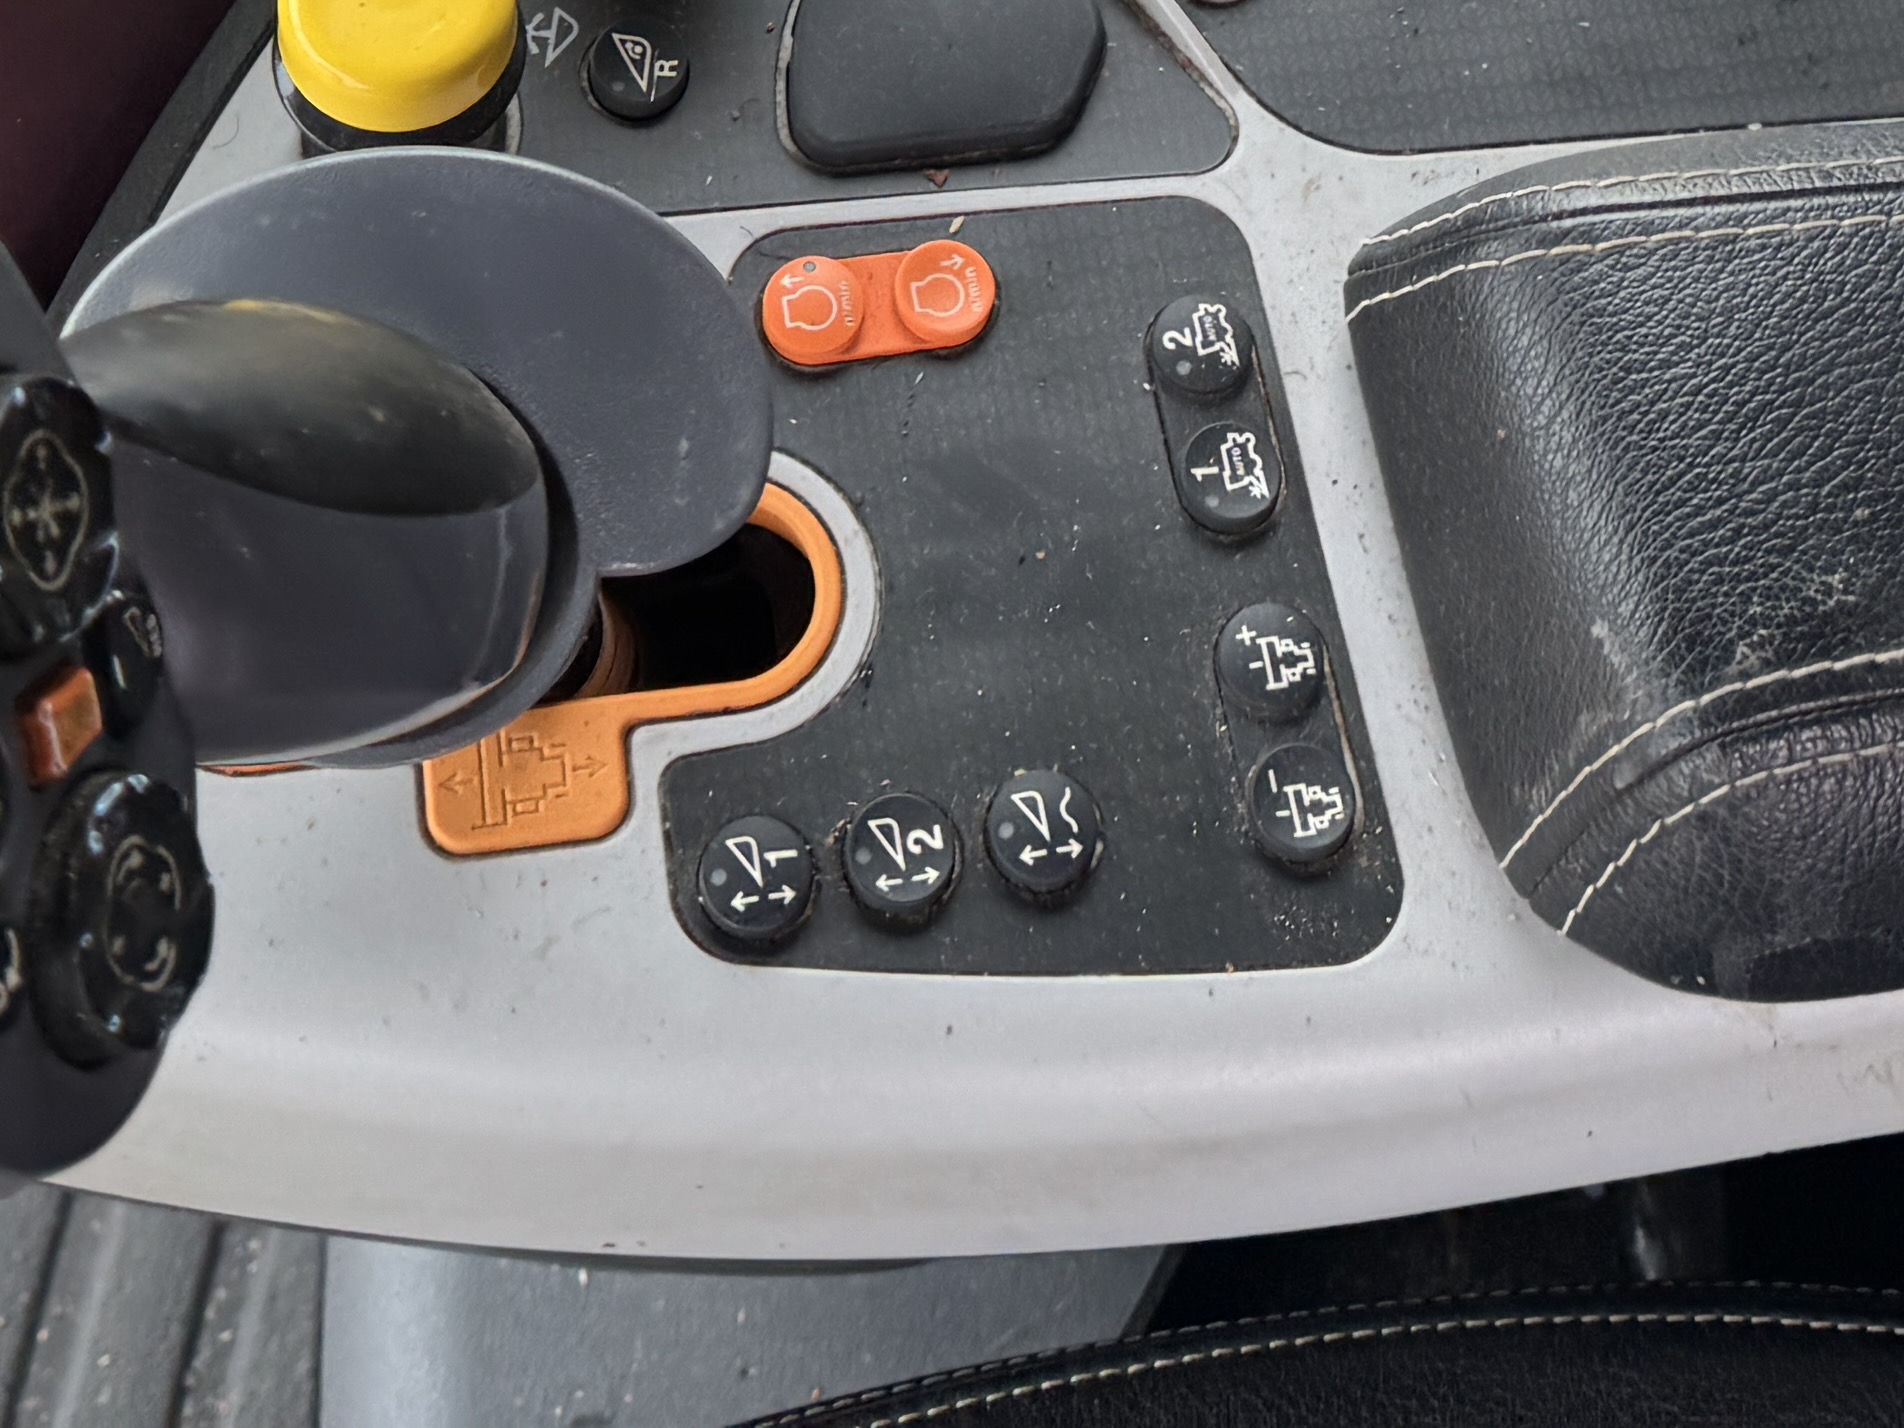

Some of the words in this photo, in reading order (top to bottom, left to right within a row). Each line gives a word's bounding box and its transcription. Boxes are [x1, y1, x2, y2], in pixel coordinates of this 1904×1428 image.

[655, 59, 679, 77] R
[1162, 326, 1194, 351] 2
[1230, 446, 1246, 477] AUTO
[1190, 465, 1220, 483] 1
[906, 824, 944, 855] 2
[763, 848, 798, 869] 1
